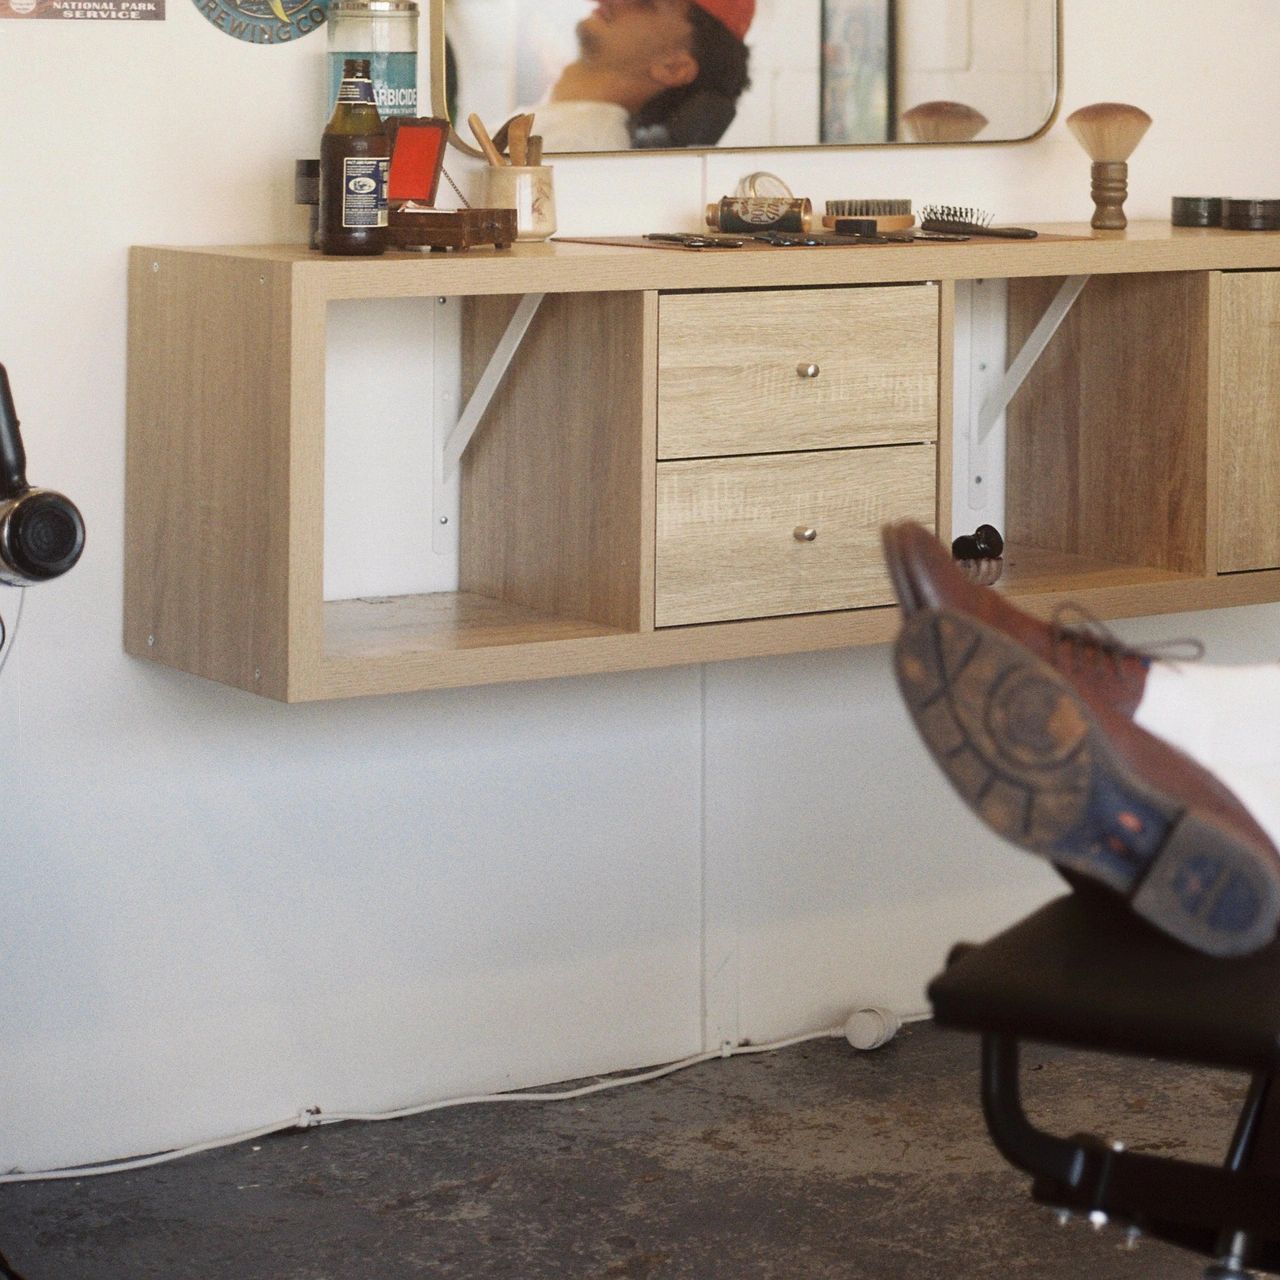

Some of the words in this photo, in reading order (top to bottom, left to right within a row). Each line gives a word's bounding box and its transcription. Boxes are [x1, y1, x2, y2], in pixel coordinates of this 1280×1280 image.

[53, 1, 118, 11] NATIONAL
[121, 2, 157, 12] PARK
[62, 10, 142, 20] SERVICE
